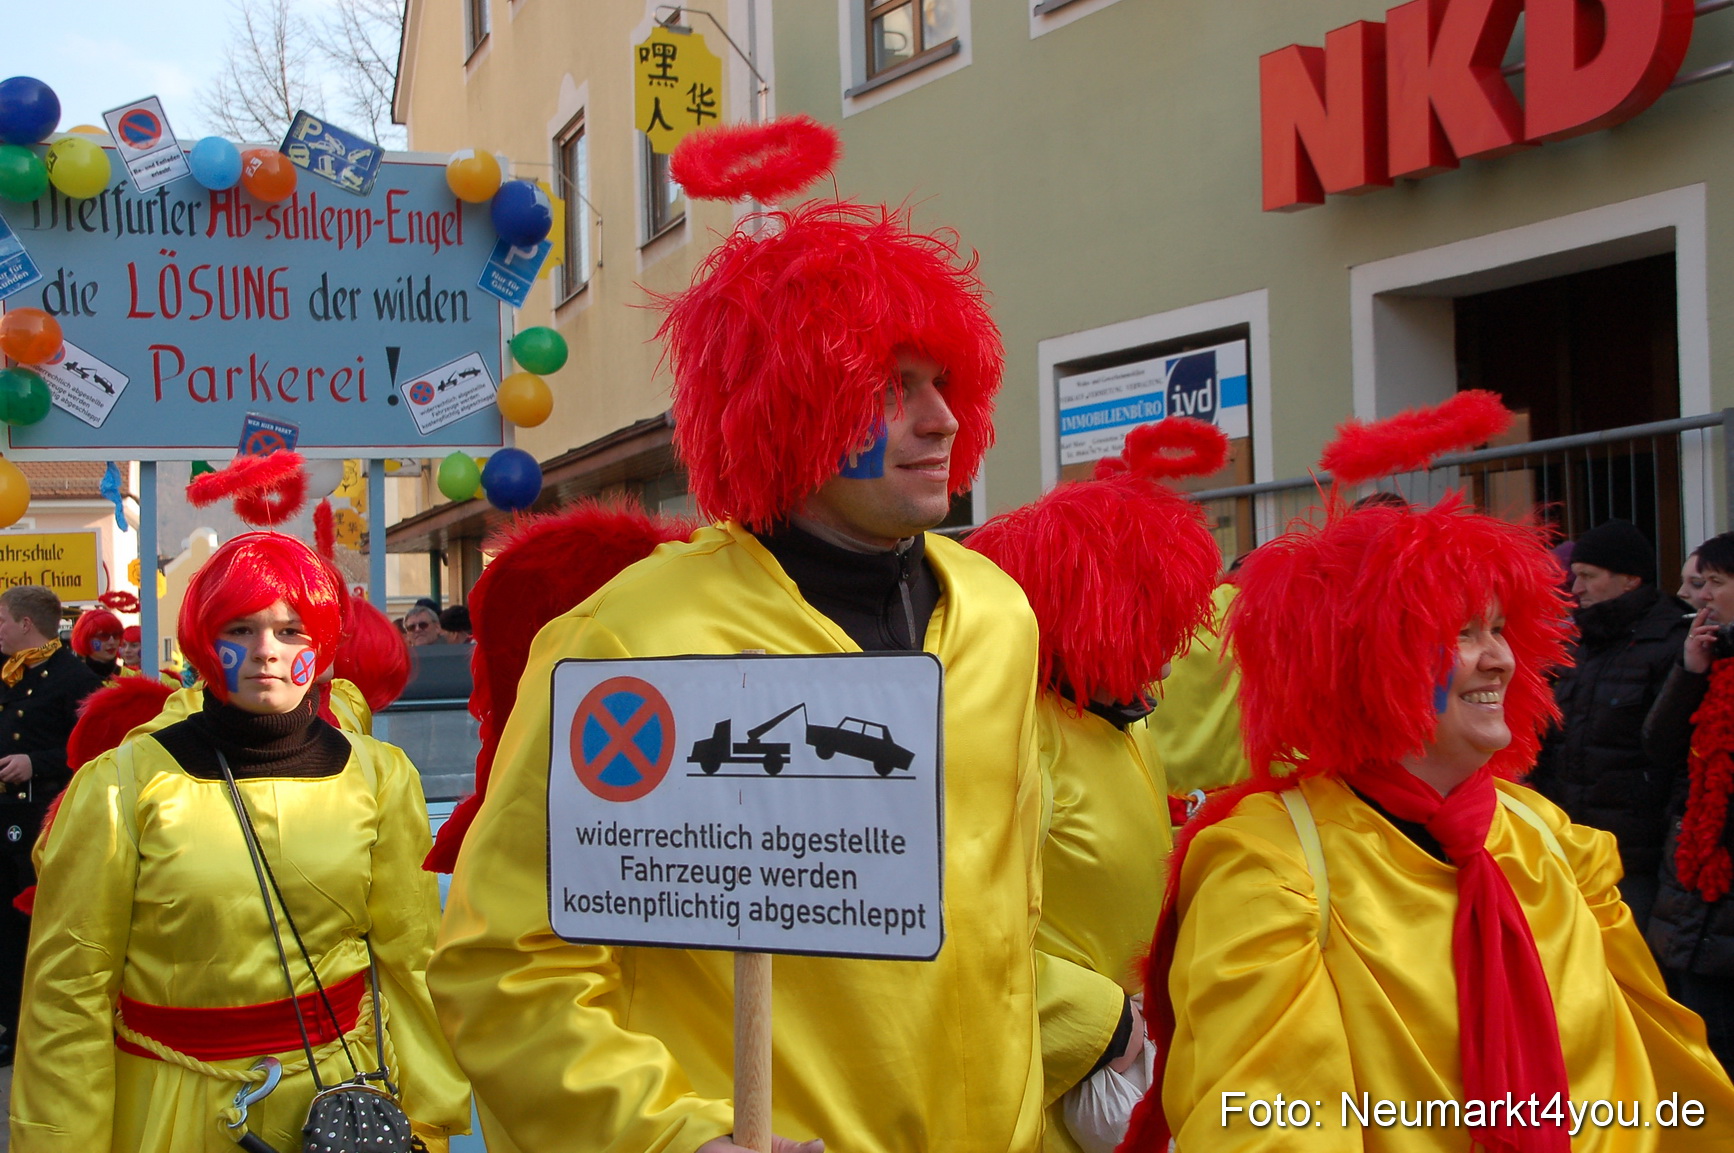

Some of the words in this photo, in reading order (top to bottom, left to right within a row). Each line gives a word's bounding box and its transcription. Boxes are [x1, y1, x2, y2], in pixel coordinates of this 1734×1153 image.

[1260, 0, 1692, 213] NKD
[298, 117, 323, 141] P
[0, 270, 29, 290] unden
[9, 263, 23, 274] für
[42, 266, 99, 317] die
[127, 248, 290, 321] LÖSUNG
[309, 272, 362, 322] der
[373, 274, 472, 324] wilden
[491, 270, 506, 284] Nur
[507, 277, 520, 291] für
[491, 280, 514, 297] Gäste
[67, 391, 91, 408] werden
[71, 385, 104, 408] abgestellte
[1171, 378, 1213, 417] ivd
[61, 395, 101, 422] abgeschleppt
[1061, 399, 1163, 432] IMMOBILIENBÜRO
[248, 419, 260, 427] WER
[260, 422, 274, 431] HIER
[0, 543, 64, 562] ahrschule
[41, 569, 83, 588] China
[576, 821, 753, 851] widerrechtlich
[761, 825, 907, 859] abgestellte
[620, 855, 752, 894] Fahrzeuge
[760, 862, 858, 890] werden
[563, 887, 741, 926] kostenpflichtig
[748, 895, 926, 936] abgeschleppt
